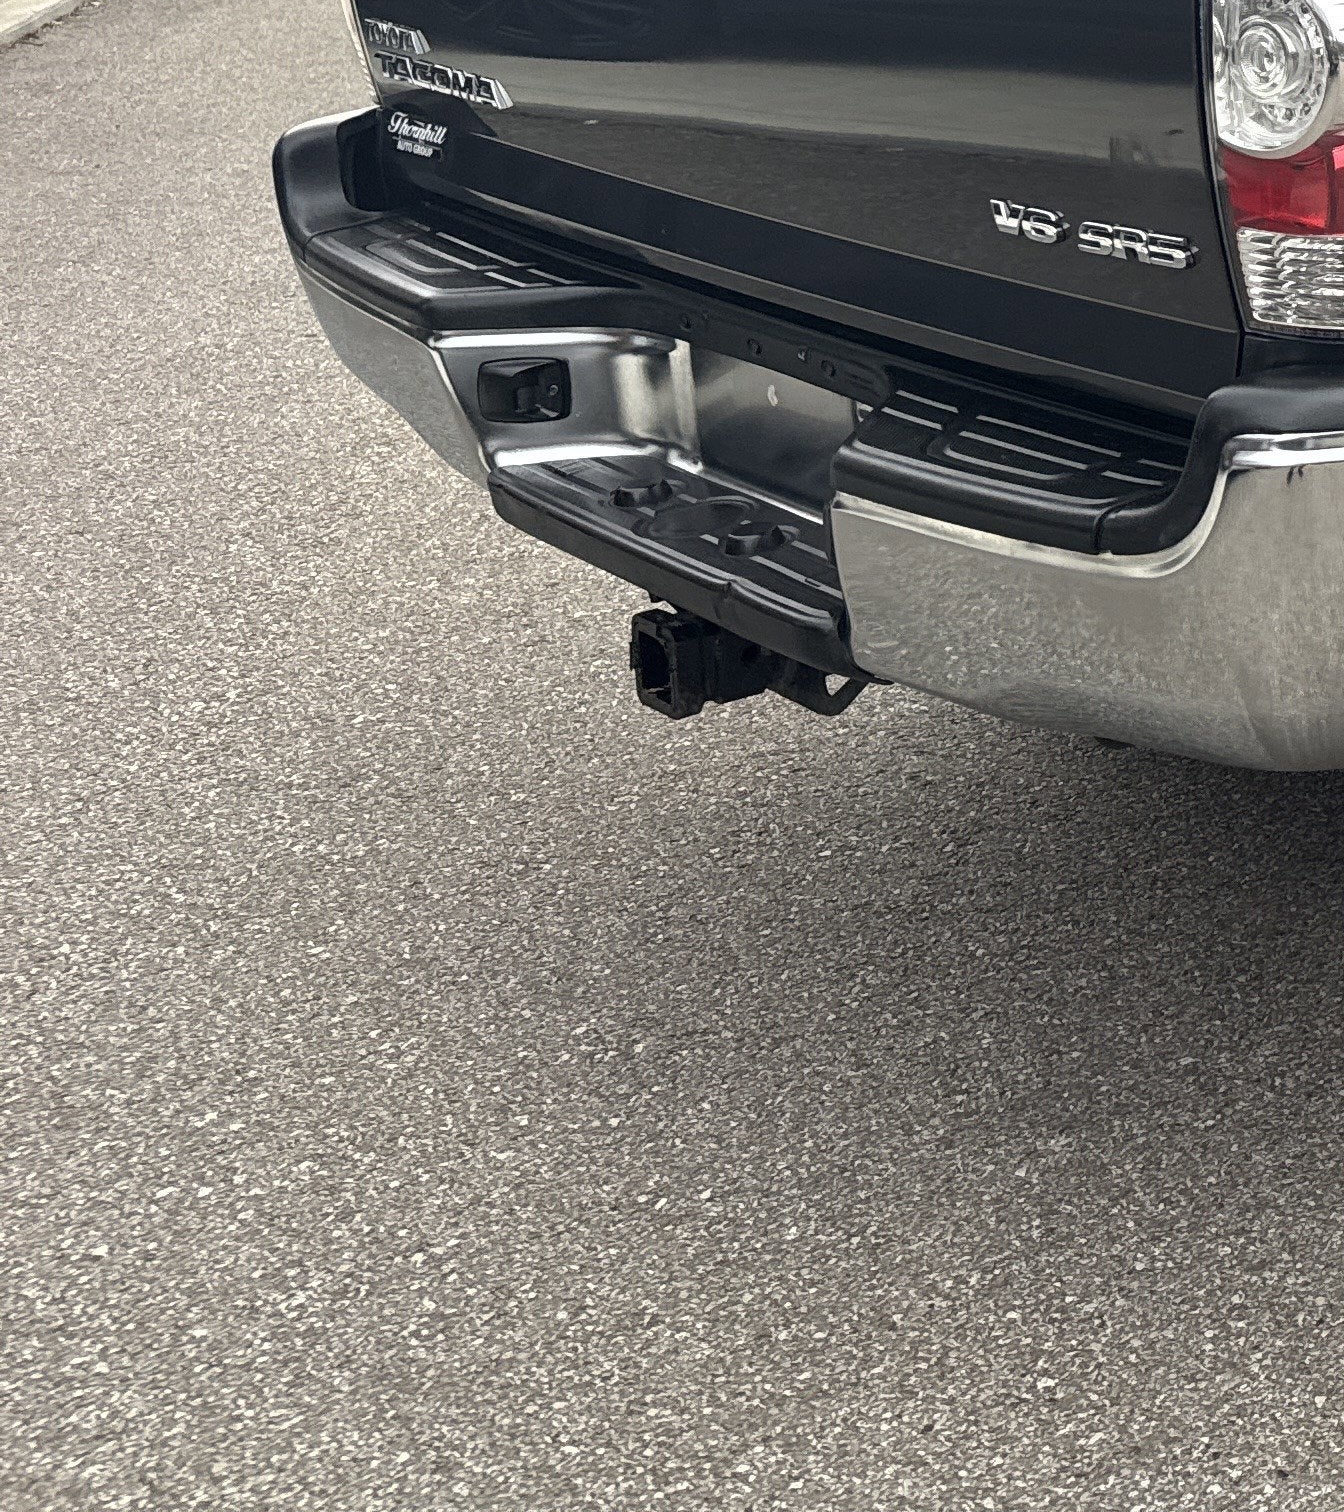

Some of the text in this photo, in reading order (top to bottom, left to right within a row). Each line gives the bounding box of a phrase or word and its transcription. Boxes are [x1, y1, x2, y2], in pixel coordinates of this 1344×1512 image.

[364, 18, 431, 55] TOYOTA
[374, 50, 514, 110] TACOMA
[387, 111, 448, 145] Thornhill
[990, 198, 1200, 269] V6 SR5
